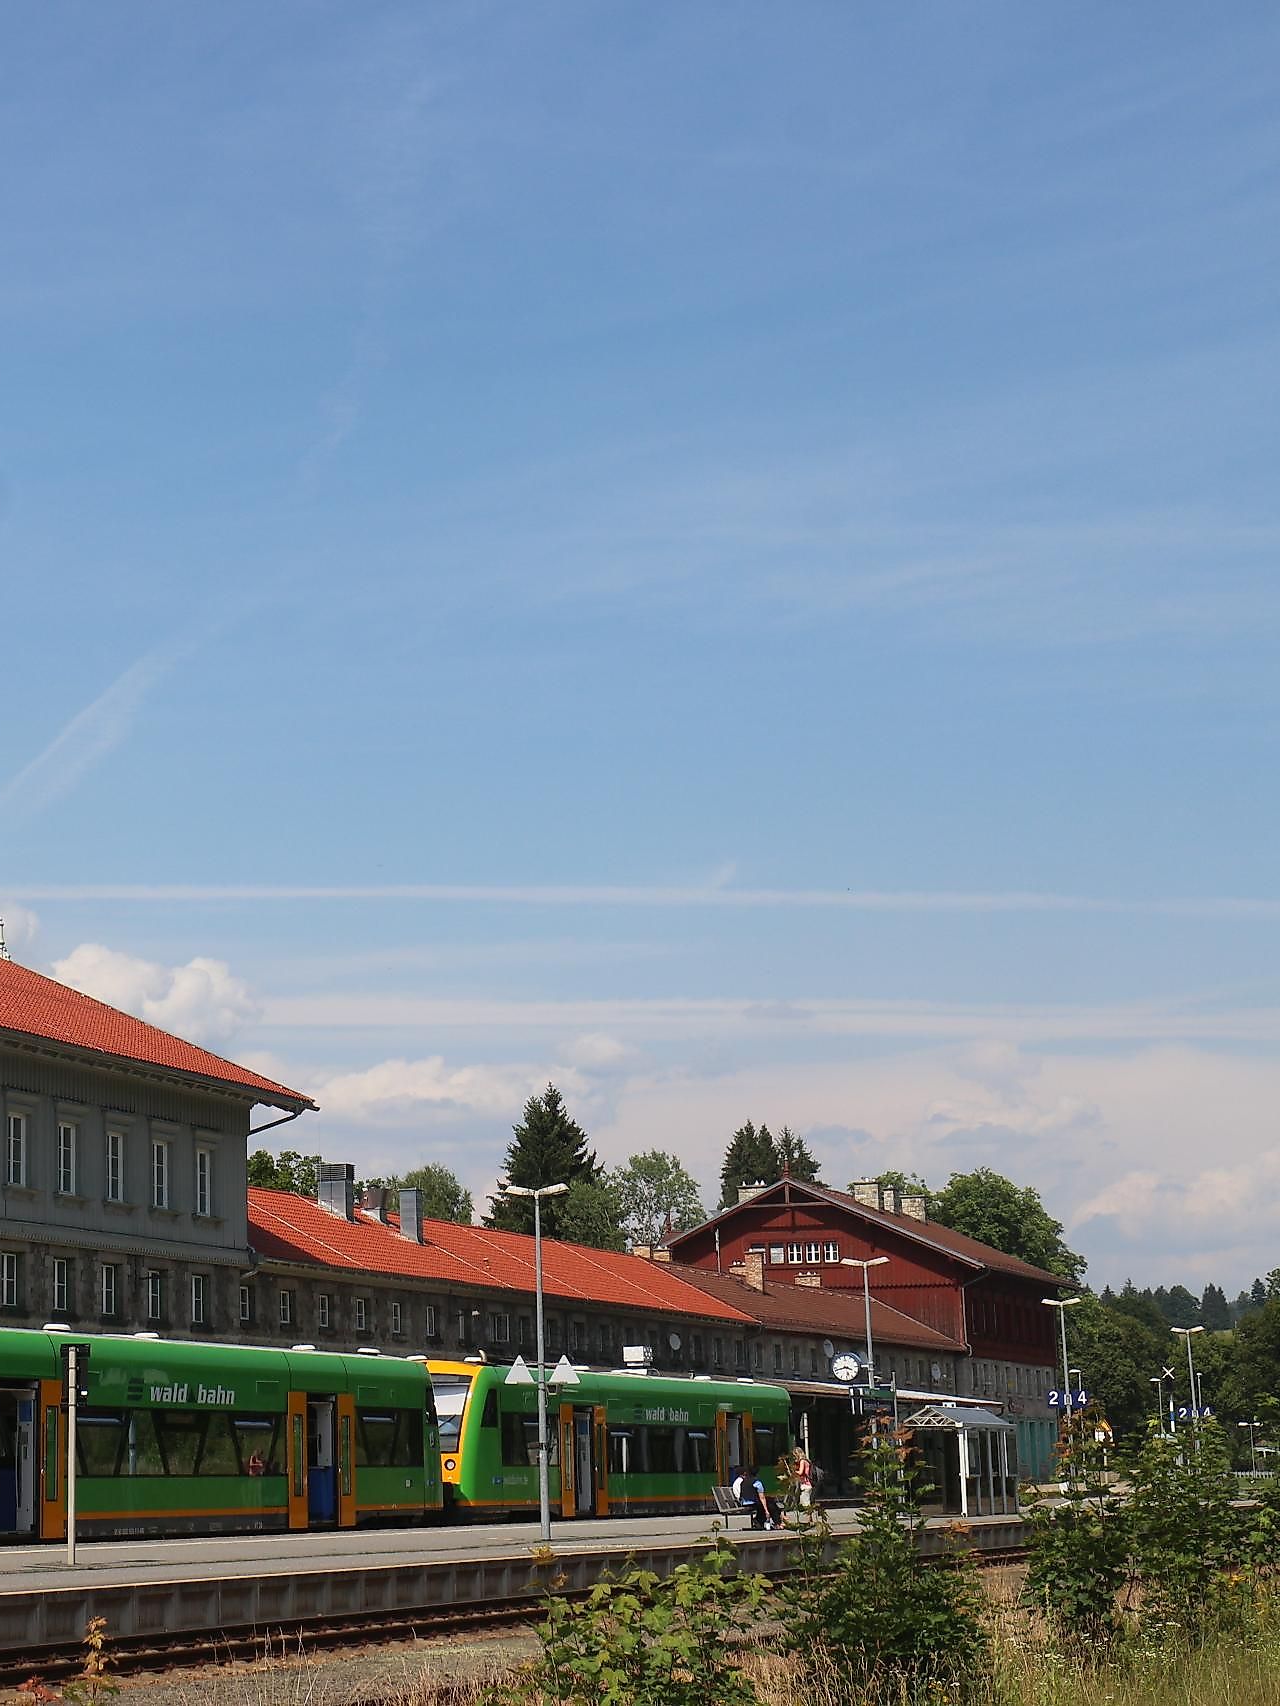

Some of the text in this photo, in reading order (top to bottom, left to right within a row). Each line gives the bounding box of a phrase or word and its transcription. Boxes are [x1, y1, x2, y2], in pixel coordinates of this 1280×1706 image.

[150, 1382, 235, 1405] wald bahn
[1048, 1391, 1059, 1405] 2
[1077, 1390, 1088, 1405] 4
[645, 1407, 689, 1422] wald bahn
[1178, 1407, 1188, 1419] 2
